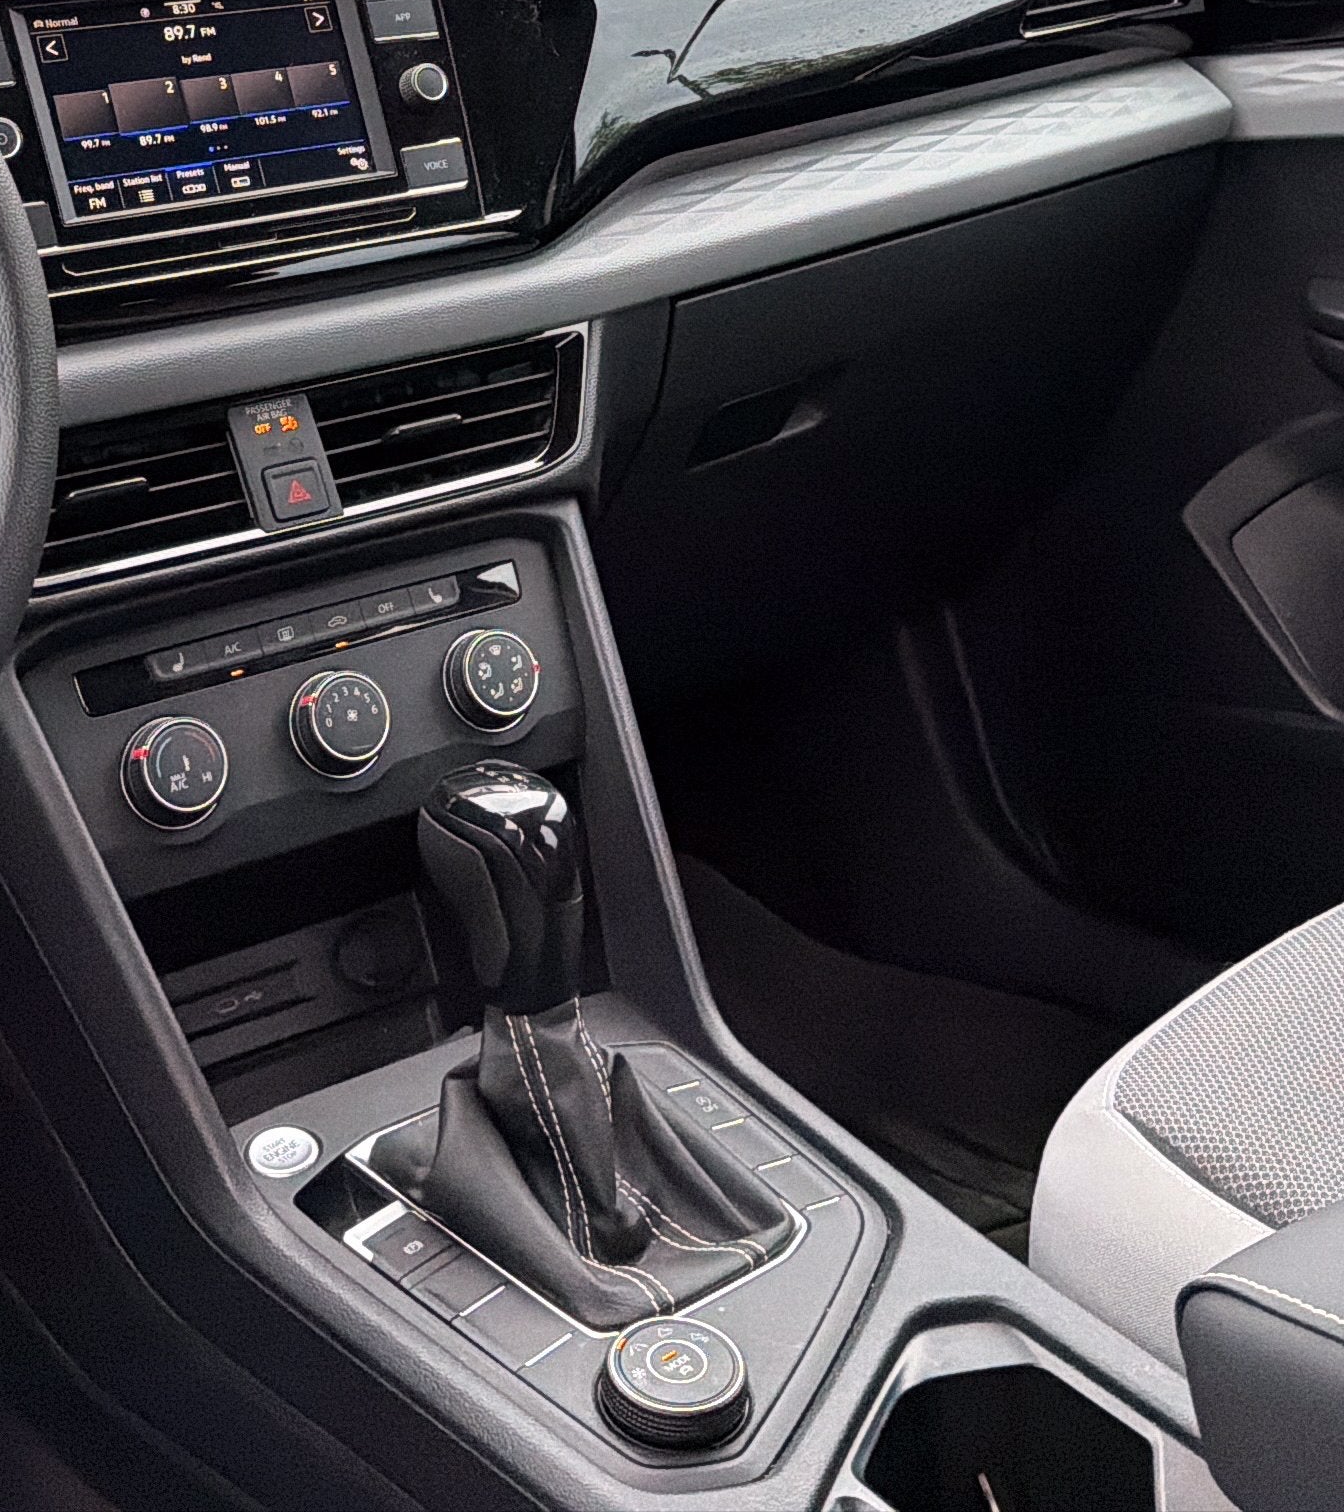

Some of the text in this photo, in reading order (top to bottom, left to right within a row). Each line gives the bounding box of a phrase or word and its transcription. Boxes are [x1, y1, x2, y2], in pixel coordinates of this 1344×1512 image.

[172, 4, 196, 15] 8:30
[45, 17, 79, 29] Normal
[164, 25, 216, 42] 89.7 FM
[328, 64, 337, 76] 5
[274, 71, 283, 82] 4
[164, 81, 174, 94] 2
[218, 77, 228, 90] 3
[102, 92, 110, 104] 1
[255, 115, 277, 126] 101.5
[81, 138, 100, 150] 99.7
[139, 134, 162, 147] 89.7
[424, 159, 448, 170] VOICE
[176, 168, 205, 180] Presets
[122, 176, 149, 188] Station
[89, 197, 106, 210] FM
[378, 601, 394, 614] OFF
[224, 642, 241, 656] A/C
[332, 692, 340, 703] 2
[341, 686, 349, 697] 3
[364, 692, 370, 703] 5
[371, 704, 378, 715] 6
[201, 771, 213, 783] HI
[170, 777, 189, 793] A/C
